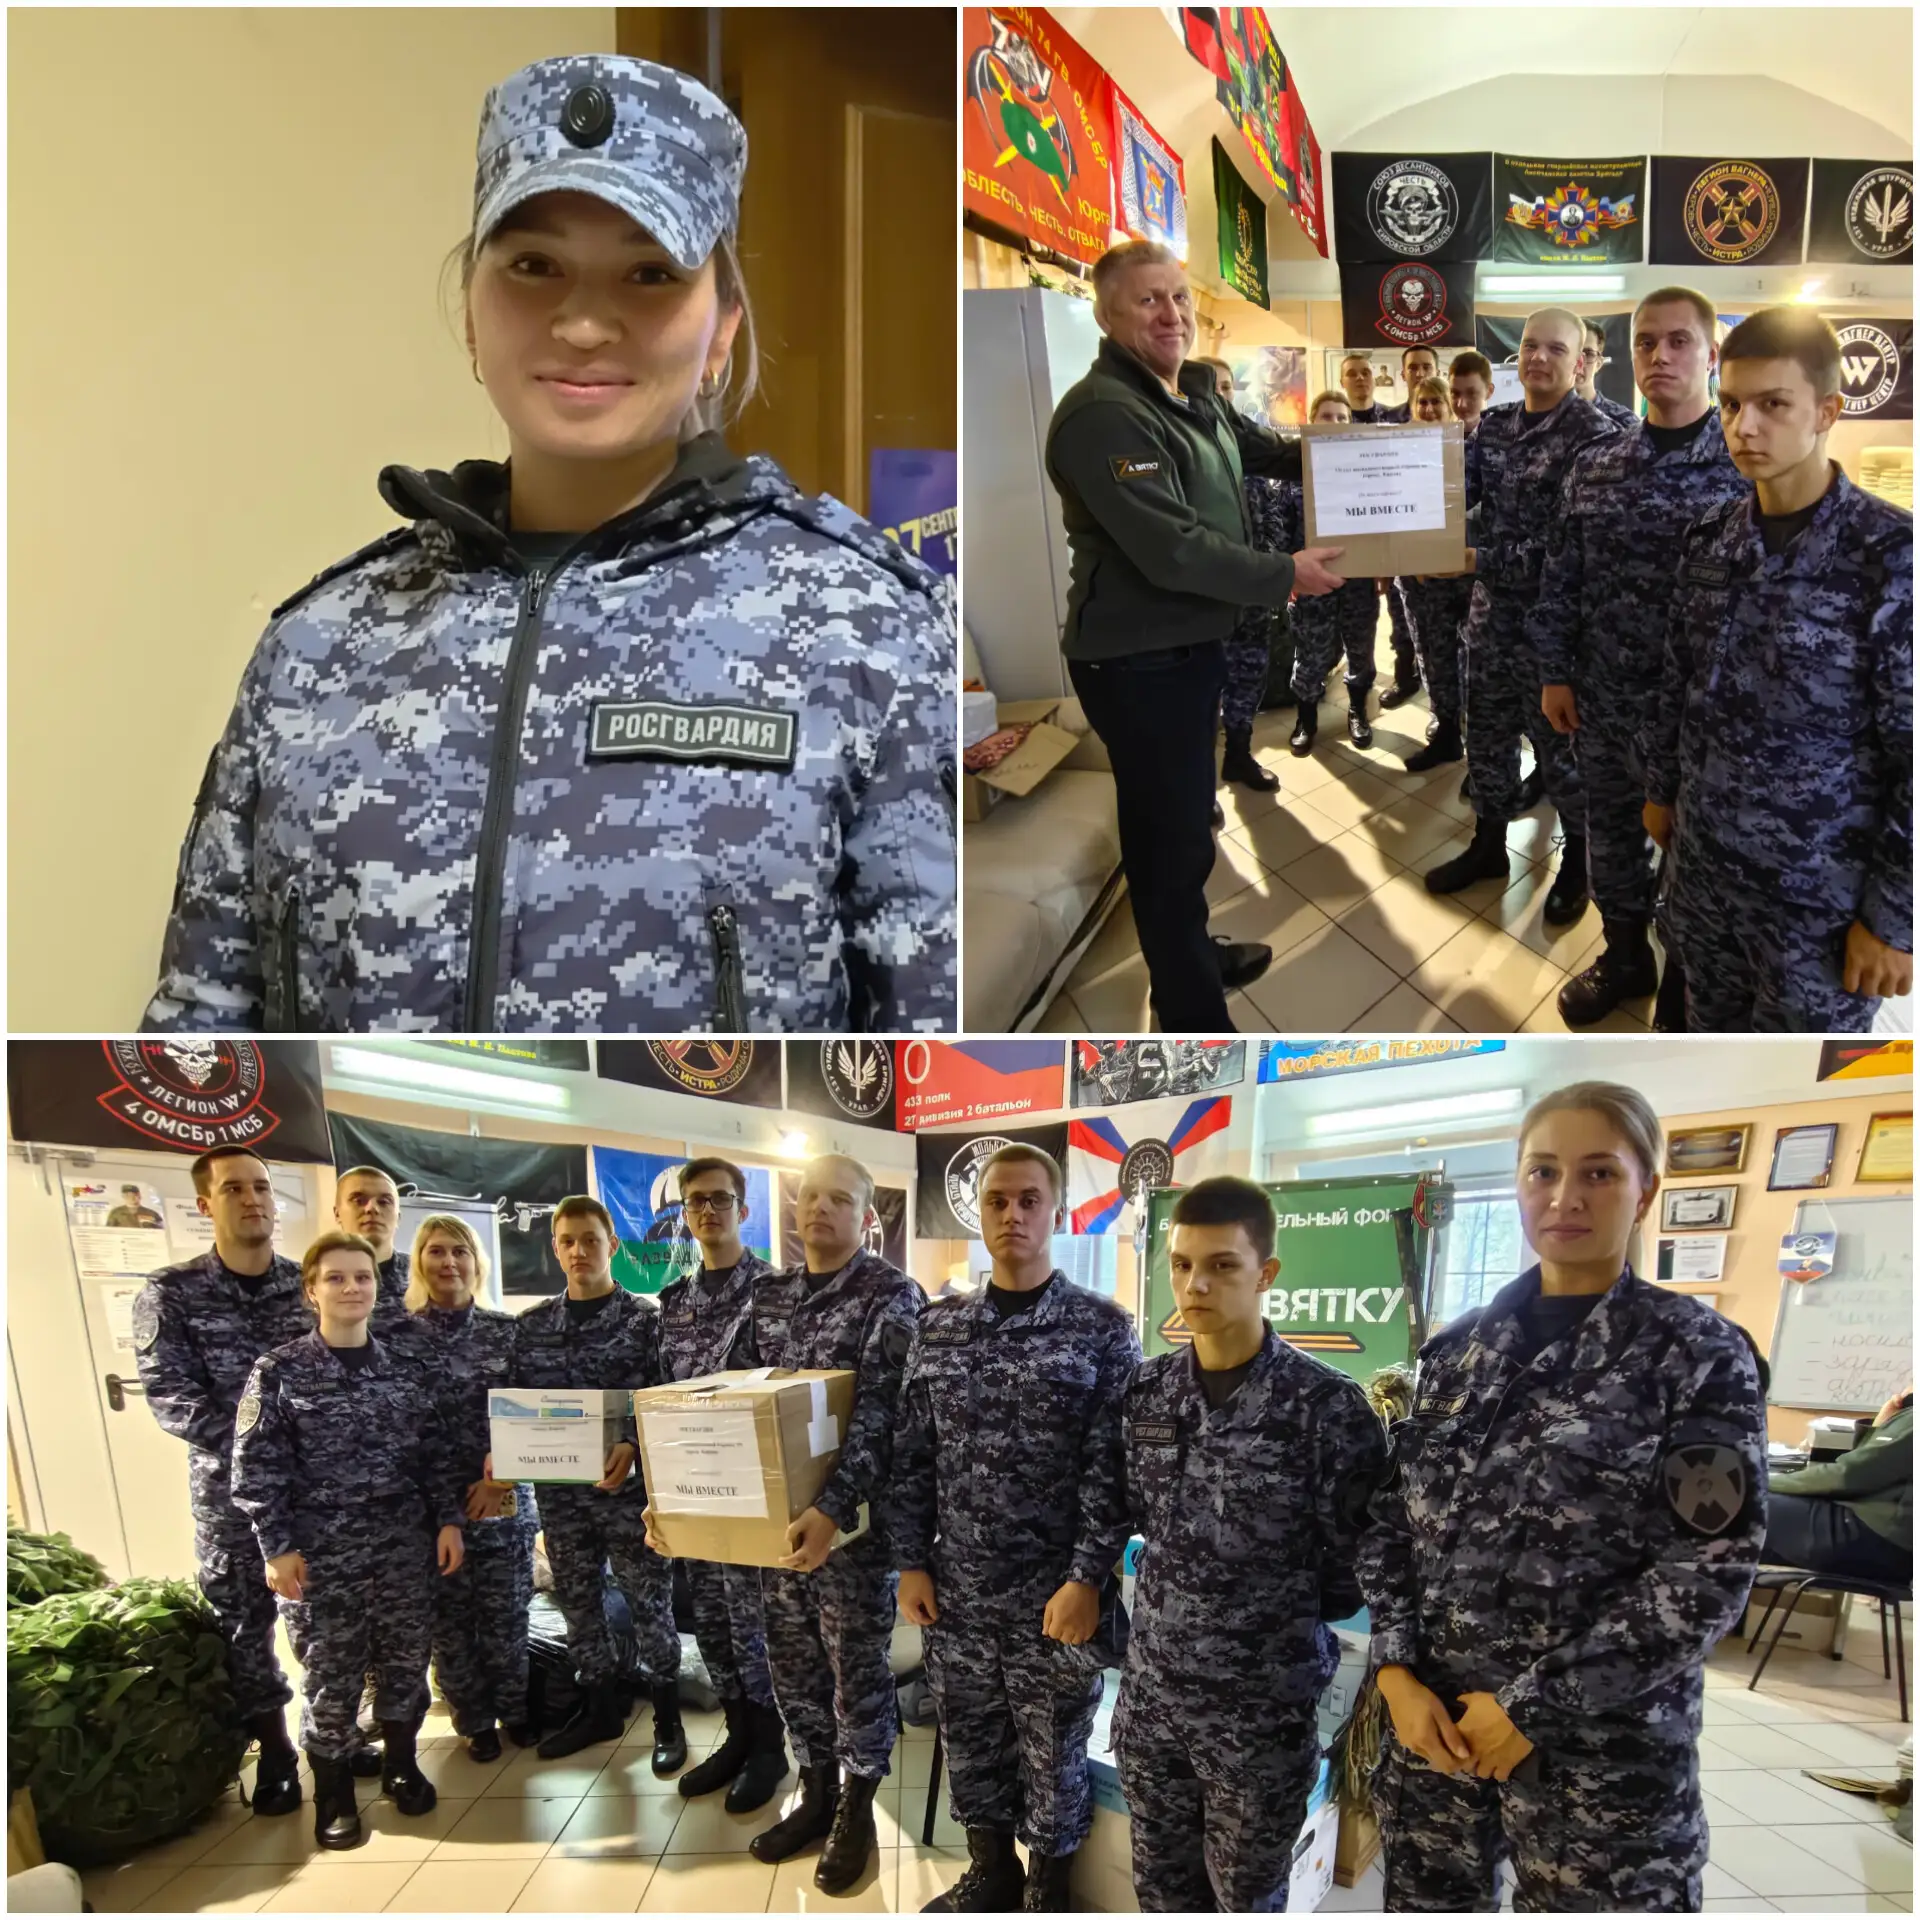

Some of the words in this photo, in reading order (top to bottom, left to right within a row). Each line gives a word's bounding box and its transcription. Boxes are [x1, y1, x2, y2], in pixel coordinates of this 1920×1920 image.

[1037, 23, 1051, 55] 74
[1073, 90, 1108, 169] ОМСБР
[1373, 167, 1395, 190] СОЮЗ
[1395, 161, 1450, 189] ДЕСАНТНИКОВ
[1400, 175, 1427, 185] ЧЕСТЬ
[1696, 166, 1729, 191] ЛЕГИОН
[1731, 165, 1767, 187] ВАГНЕРА
[1077, 195, 1111, 225] Юрга
[1068, 226, 1106, 252] ОТВАГА
[1376, 227, 1420, 254] КИРОВСКОЙ
[1423, 224, 1453, 252] ОБЛАСТИ
[1712, 247, 1744, 260] ИСТРА
[1383, 322, 1392, 331] 4
[1389, 326, 1419, 342] ОМСБр
[1425, 321, 1443, 337] МСБ
[1875, 333, 1897, 365] ЦЕНТР
[1840, 355, 1881, 387] W
[1843, 398, 1868, 411] ГНЕР
[1869, 377, 1894, 406] ЦЕНТР
[1345, 506, 1367, 517] МЫ
[1370, 503, 1417, 516] ВМЕСТЕ
[608, 712, 777, 749] РОСГВАРДИЯ
[720, 1054, 748, 1087] РОДИНА
[1277, 1047, 1381, 1076] МОРСКАЯ
[1387, 1040, 1483, 1061] ПЕХОТА
[680, 1070, 717, 1090] ИСТРА
[150, 1085, 219, 1115] ЛЕГИОН
[219, 1093, 239, 1112] W
[904, 1094, 922, 1108] 433
[925, 1091, 951, 1105] полк
[904, 1114, 917, 1127] 27
[919, 1108, 963, 1125] дивизия
[967, 1104, 973, 1117] 2
[975, 1098, 1032, 1115] батальон
[124, 1101, 142, 1114] 4
[142, 1110, 216, 1146] ОМСБр
[218, 1126, 228, 1141] 1
[230, 1113, 264, 1139] МСБ
[1261, 1287, 1405, 1324] ВЯТКУ
[519, 1455, 536, 1464] МЫ
[538, 1455, 580, 1464] ВМЕСТЕ
[675, 1485, 693, 1496] МЫ
[696, 1486, 739, 1496] ВМЕСТЕ
